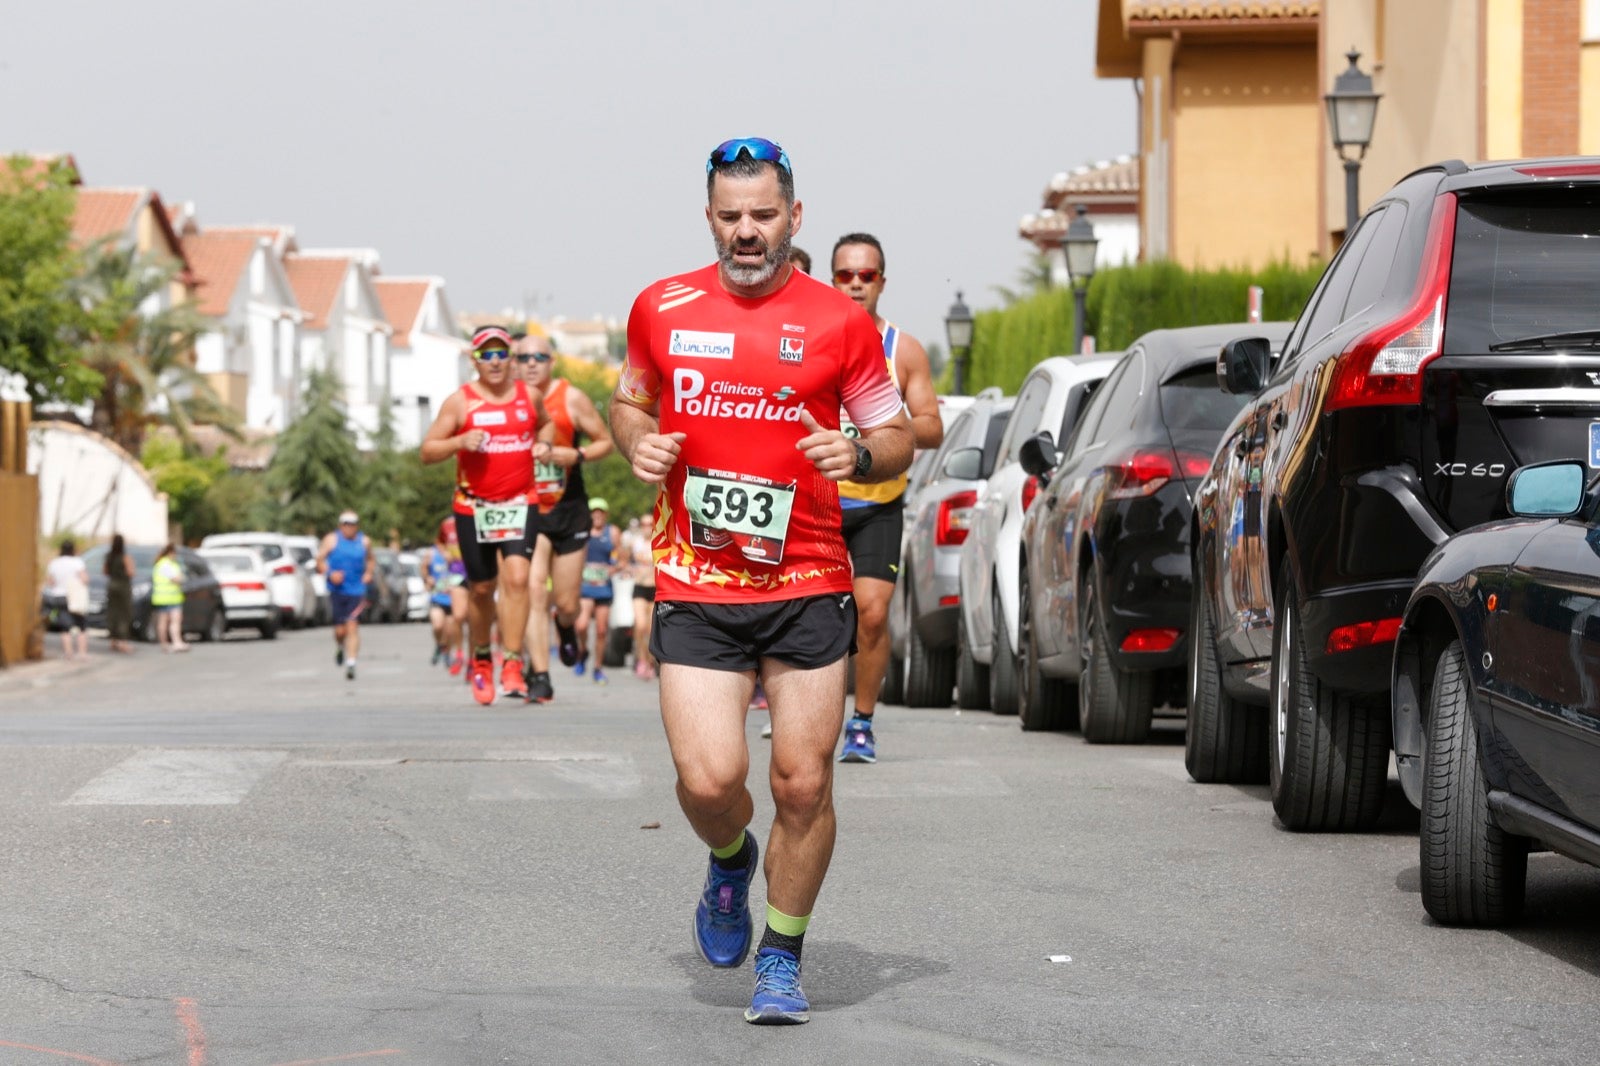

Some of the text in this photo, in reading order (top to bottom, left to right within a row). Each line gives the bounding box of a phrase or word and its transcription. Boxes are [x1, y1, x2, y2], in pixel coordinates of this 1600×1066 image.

[780, 351, 802, 361] MOVE
[673, 367, 805, 422] Polisalud
[710, 381, 764, 397] Clínicas
[701, 484, 773, 528] 593
[484, 509, 518, 526] 627
